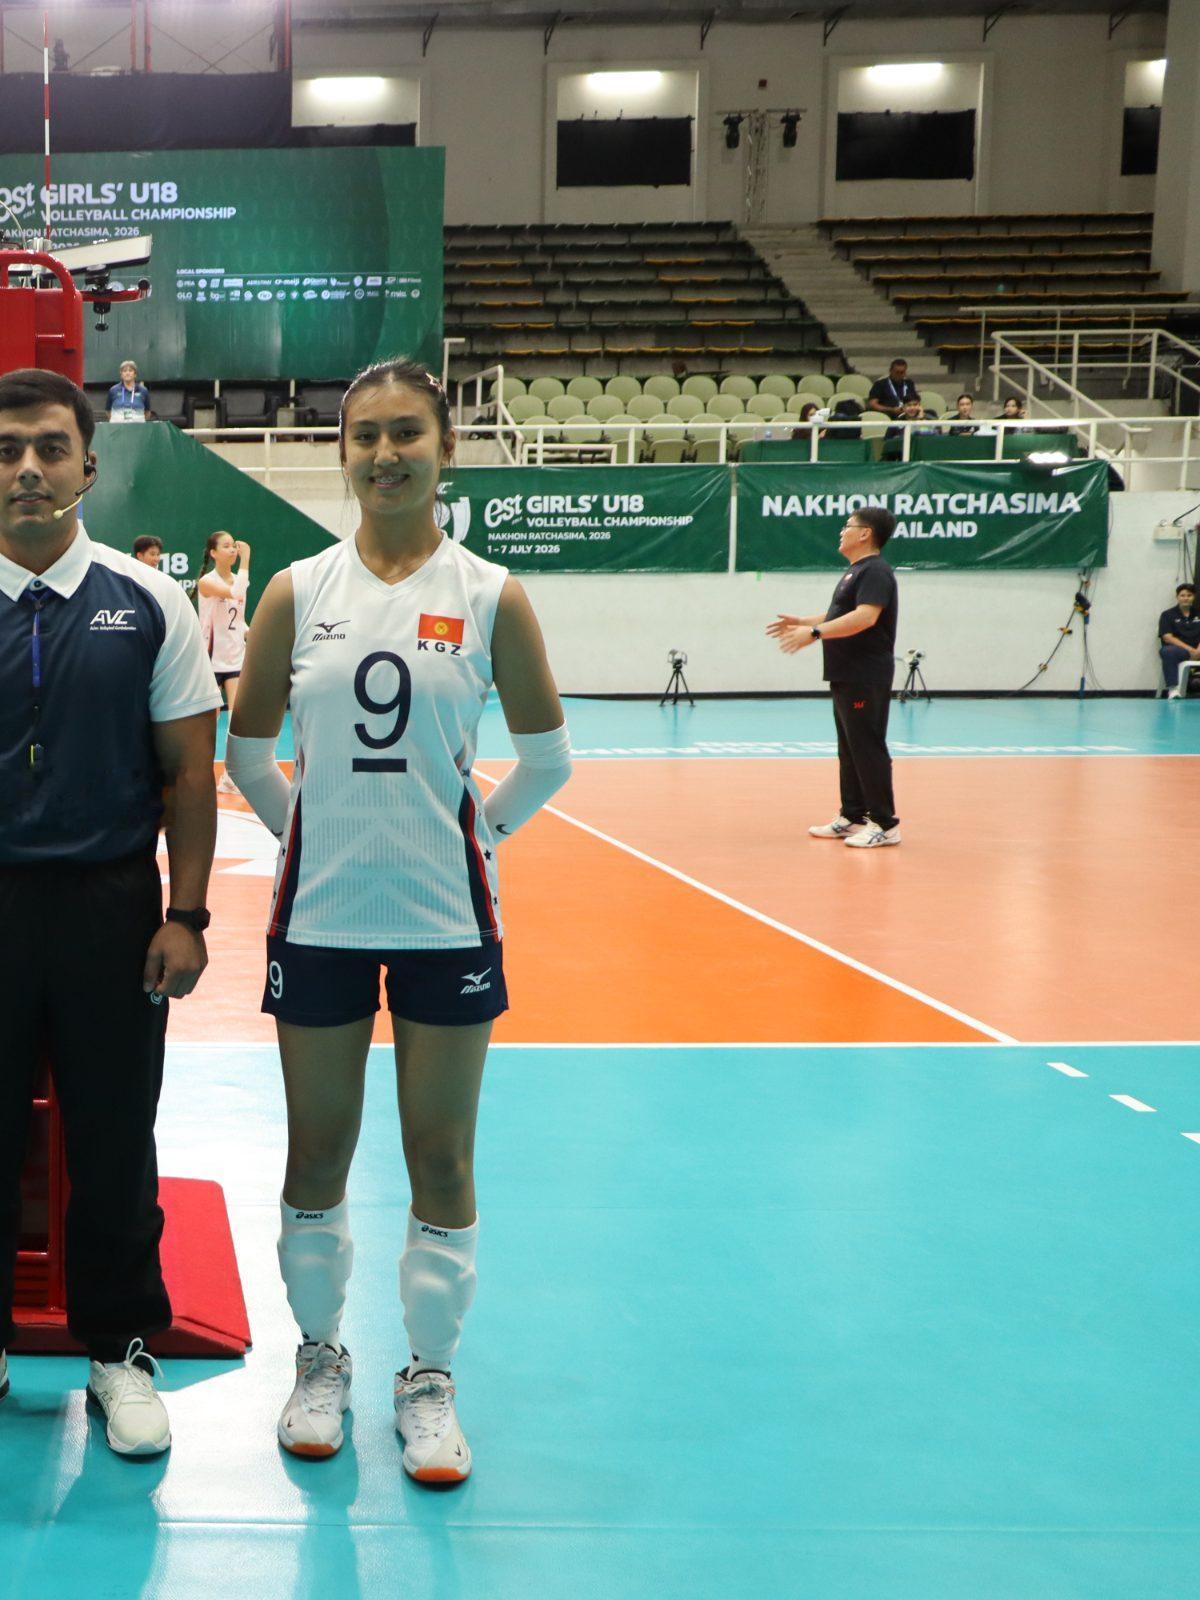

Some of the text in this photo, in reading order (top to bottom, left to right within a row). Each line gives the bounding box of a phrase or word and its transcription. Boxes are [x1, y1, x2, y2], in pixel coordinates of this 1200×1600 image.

[130, 181, 178, 204] U18
[41, 209, 128, 222] VOLLEYBALL
[131, 207, 236, 220] CHAMPIONSHIP
[4, 228, 41, 238] AKHON
[114, 227, 140, 237] 2026
[484, 493, 523, 528] est
[526, 494, 644, 514] GIRLS' U18
[894, 492, 1082, 515] RATCHASIMA
[527, 516, 601, 528] VOLLEYBALL
[603, 515, 694, 527] CHAMPIONSHIP
[893, 520, 978, 538] AILAND
[488, 532, 527, 541] NAKHON
[589, 531, 611, 540] 2026
[487, 545, 492, 554] 1
[501, 545, 508, 554] 7
[508, 545, 532, 554] JULY
[534, 544, 561, 554] 2026
[158, 552, 189, 575] 18
[90, 609, 136, 625] AVC
[228, 607, 238, 630] 2
[417, 639, 462, 656] KGZ
[354, 651, 412, 750] 9
[269, 960, 284, 999] 9
